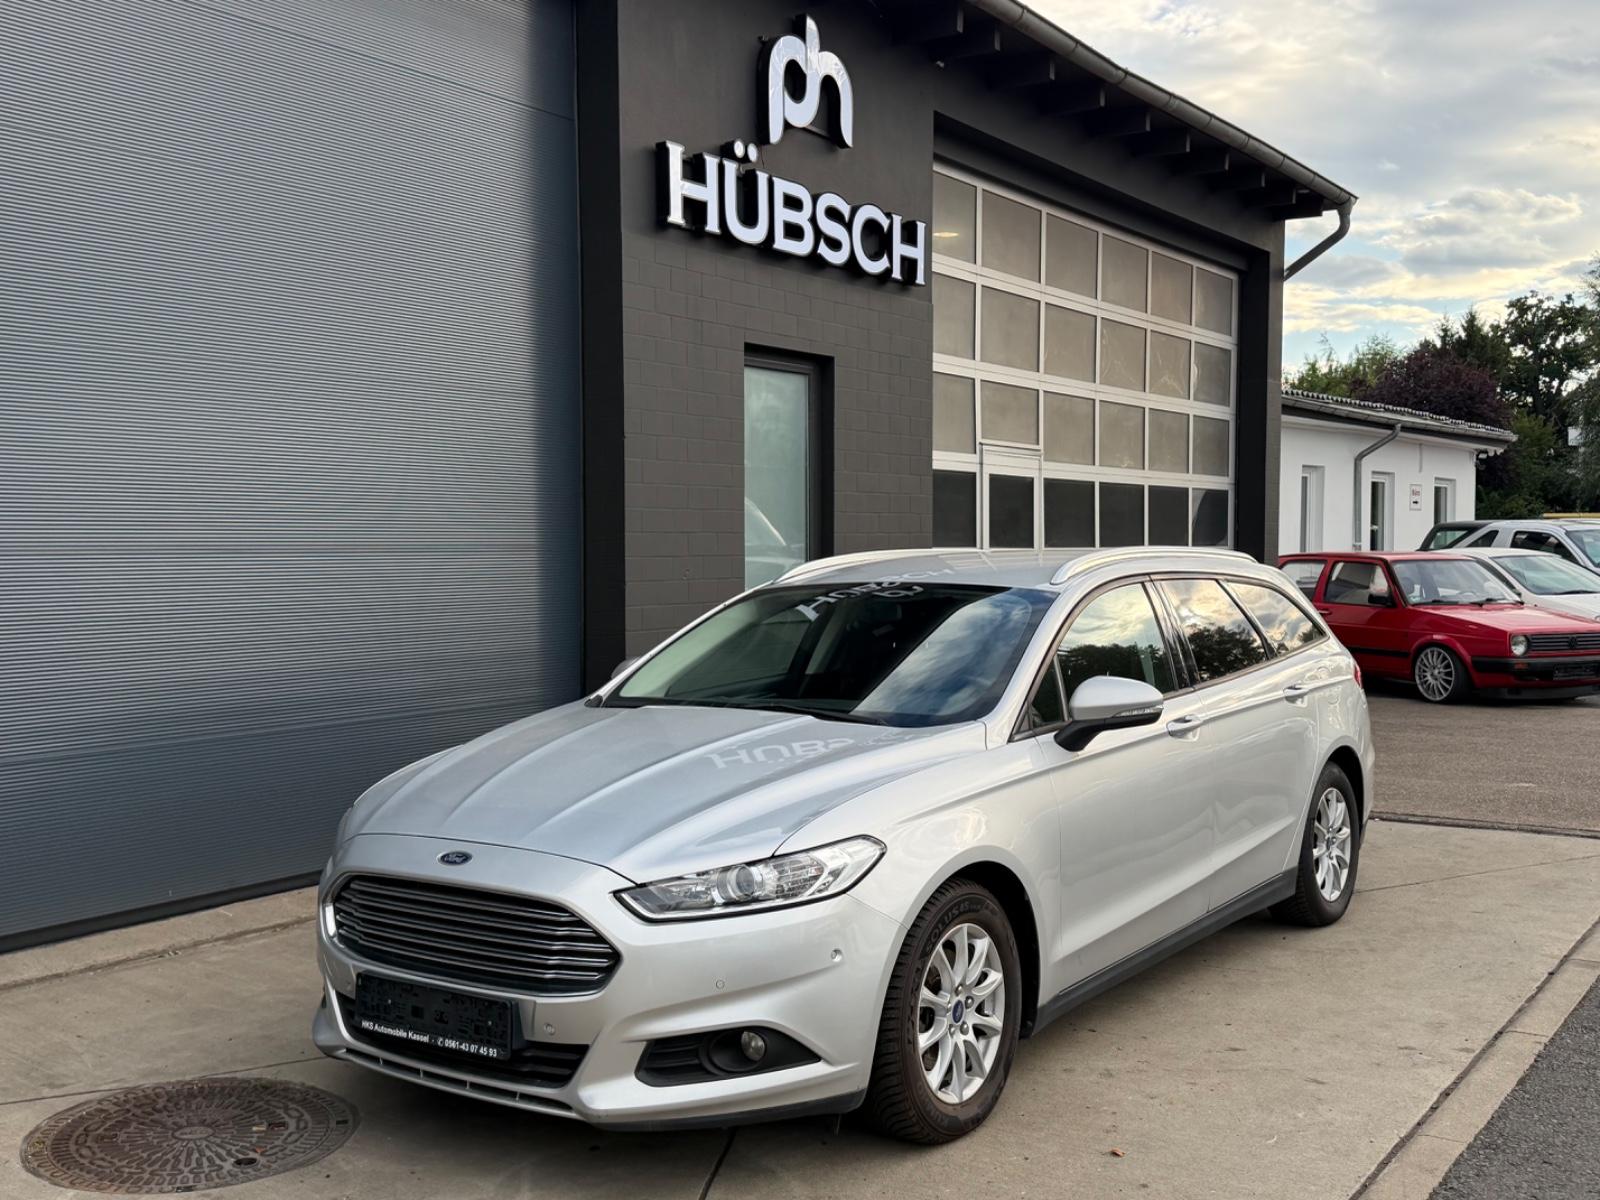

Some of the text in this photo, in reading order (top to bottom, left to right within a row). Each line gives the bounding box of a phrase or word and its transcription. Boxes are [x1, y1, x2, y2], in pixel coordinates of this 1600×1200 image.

[664, 138, 927, 286] HÜBSCH
[361, 1019, 497, 1058] HKS Automobile Kassel 0561-43 07 45 93
